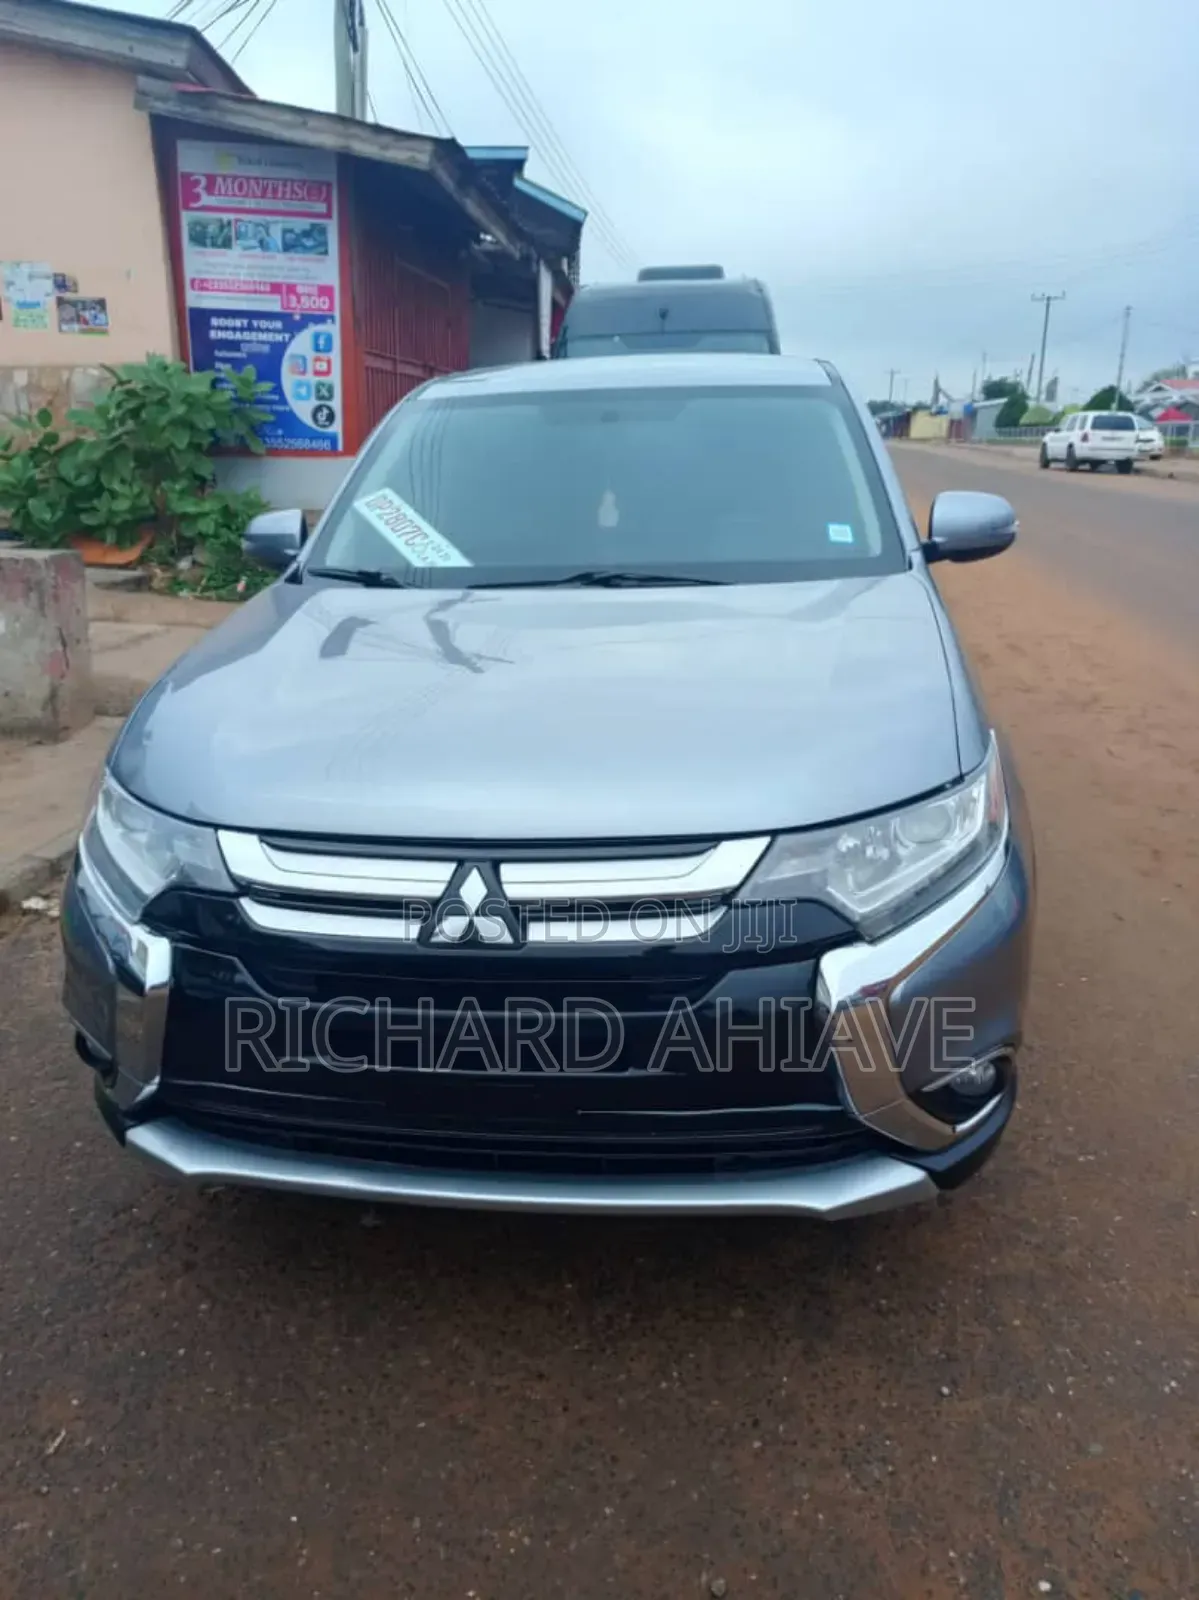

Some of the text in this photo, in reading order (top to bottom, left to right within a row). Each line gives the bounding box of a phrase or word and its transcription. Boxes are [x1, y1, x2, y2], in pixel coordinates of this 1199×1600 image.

[188, 175, 208, 208] 3
[252, 319, 283, 330] YOUR
[208, 329, 291, 343] ENGAGEMENT
